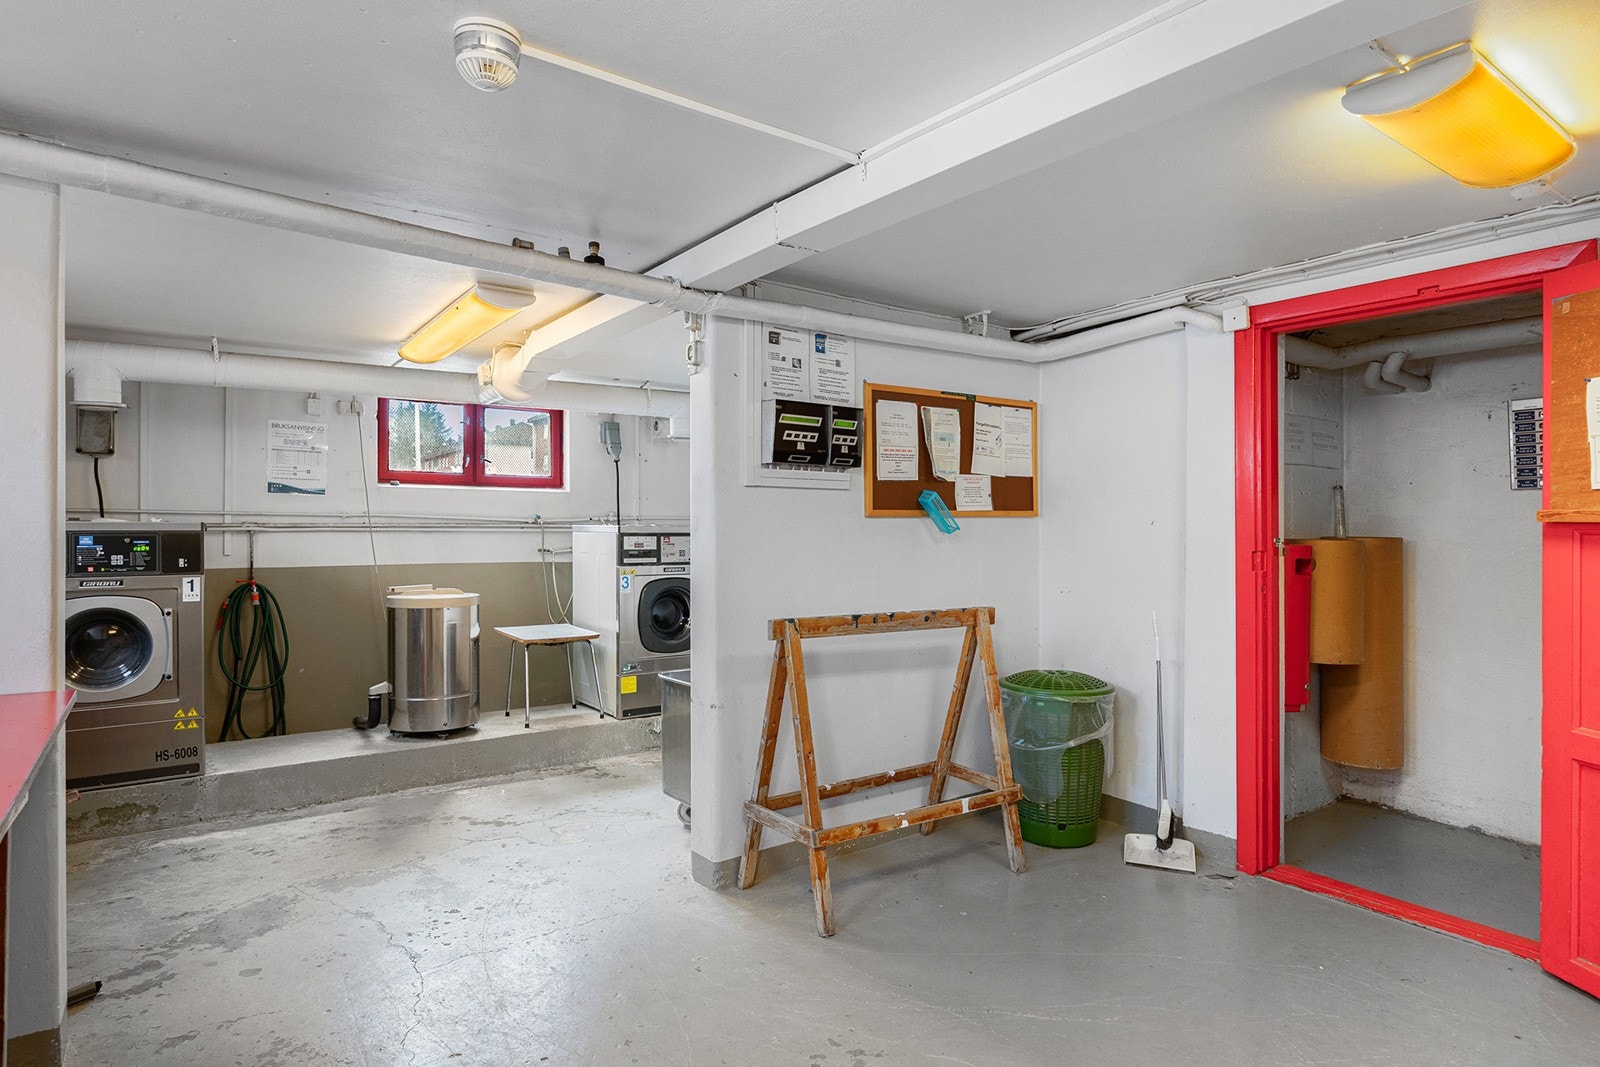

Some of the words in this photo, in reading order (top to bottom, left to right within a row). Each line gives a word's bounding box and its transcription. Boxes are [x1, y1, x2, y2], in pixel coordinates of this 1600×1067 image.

[271, 422, 325, 432] BRUKSANVISNING
[186, 579, 194, 592] 1
[621, 576, 630, 589] 3
[155, 746, 198, 762] HS-6008
